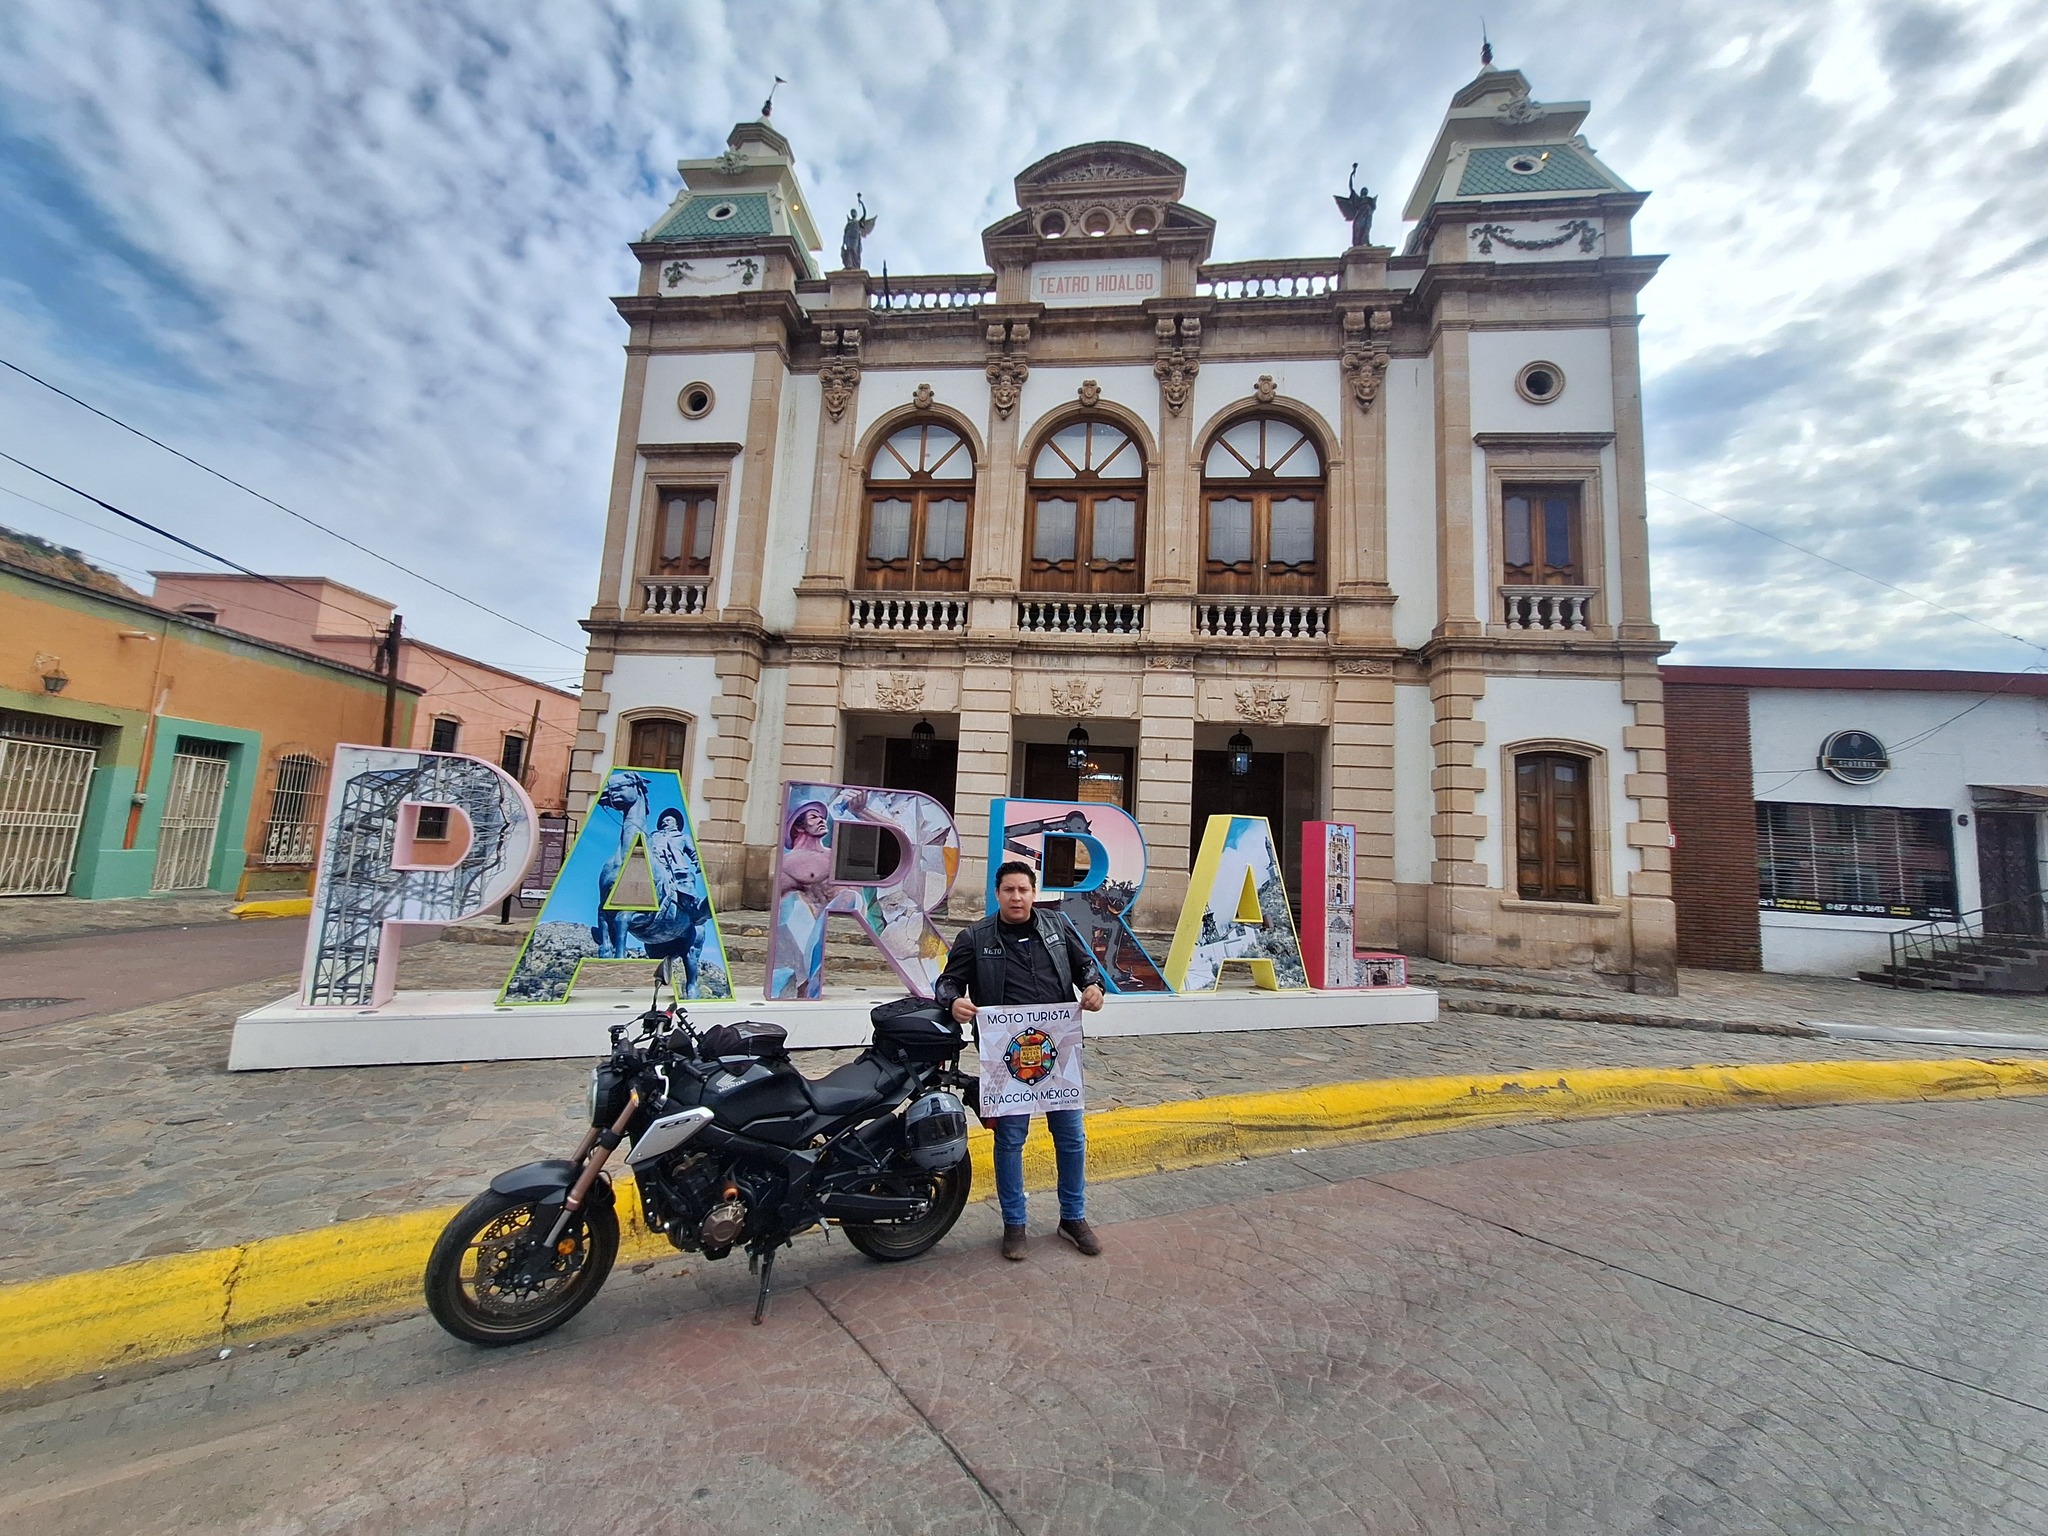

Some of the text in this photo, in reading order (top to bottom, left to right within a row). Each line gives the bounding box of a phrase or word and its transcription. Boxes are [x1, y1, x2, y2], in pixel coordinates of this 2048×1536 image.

[1039, 273, 1154, 294] TEATRO HIDALGO
[1957, 814, 1969, 827] 6
[296, 742, 1408, 1011] PARRAL
[983, 947, 1002, 955] NETO
[987, 1010, 1071, 1025] MOTO TURISTA
[718, 1079, 747, 1092] HONDA
[983, 1095, 996, 1106] EN
[998, 1089, 1038, 1105] ACCIÓN
[1040, 1087, 1080, 1100] MÉXICO
